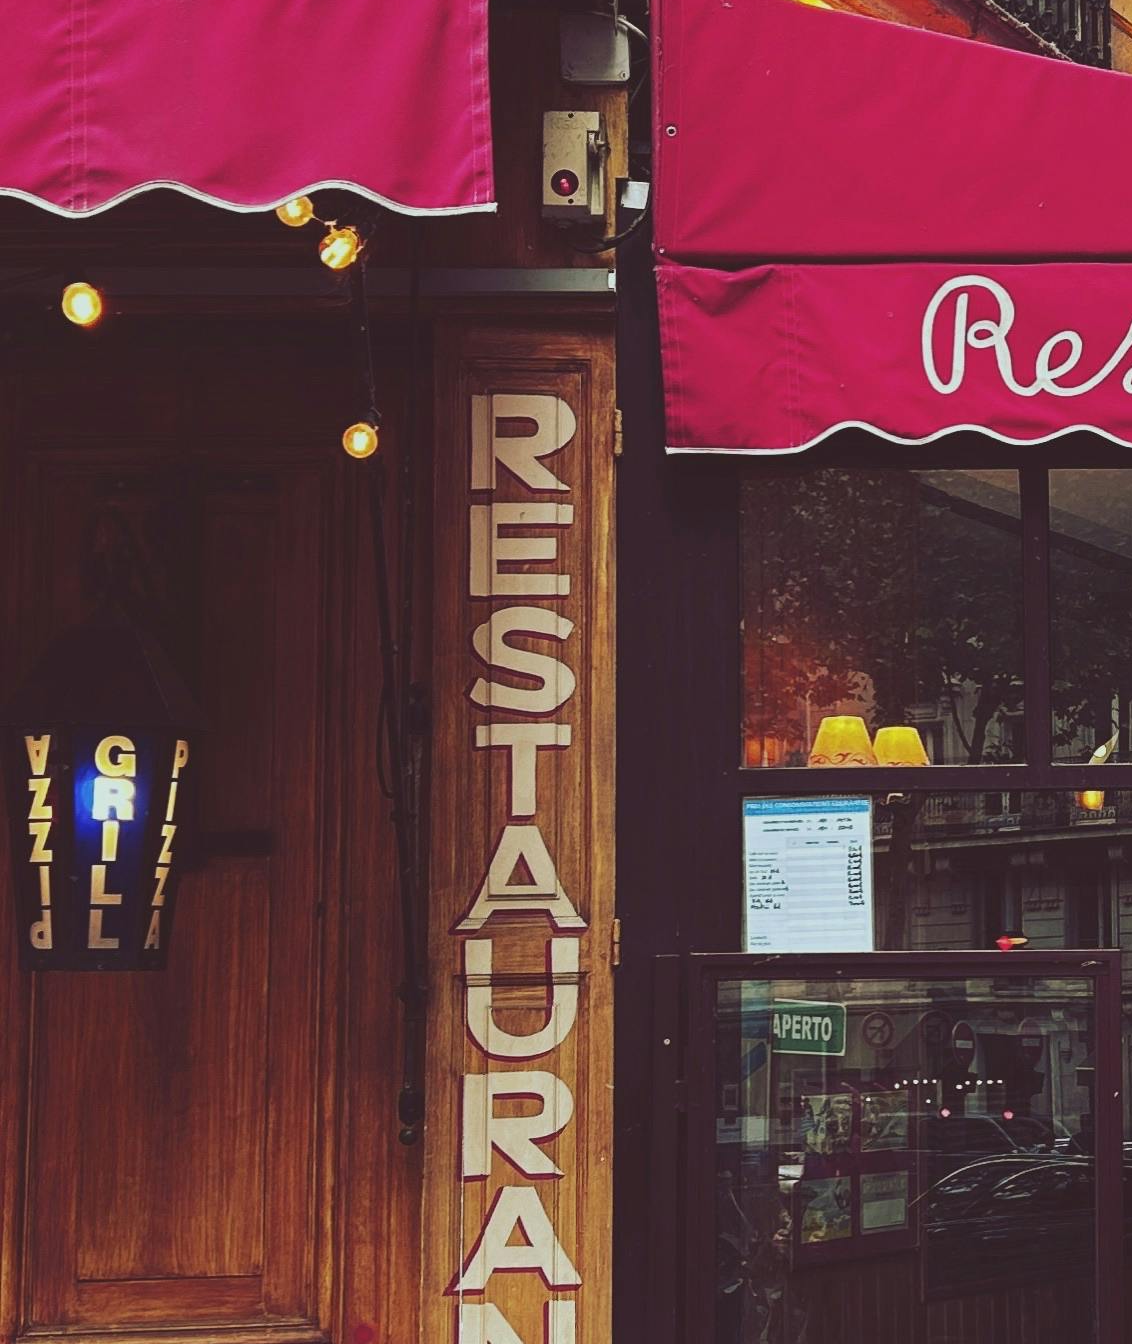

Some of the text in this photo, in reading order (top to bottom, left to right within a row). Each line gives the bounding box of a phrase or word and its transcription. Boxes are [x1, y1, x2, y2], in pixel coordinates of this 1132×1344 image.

[24, 734, 53, 949] PIZZA
[88, 735, 137, 949] GRILL
[143, 739, 189, 949] PIZZA
[772, 1012, 833, 1042] APERTO
